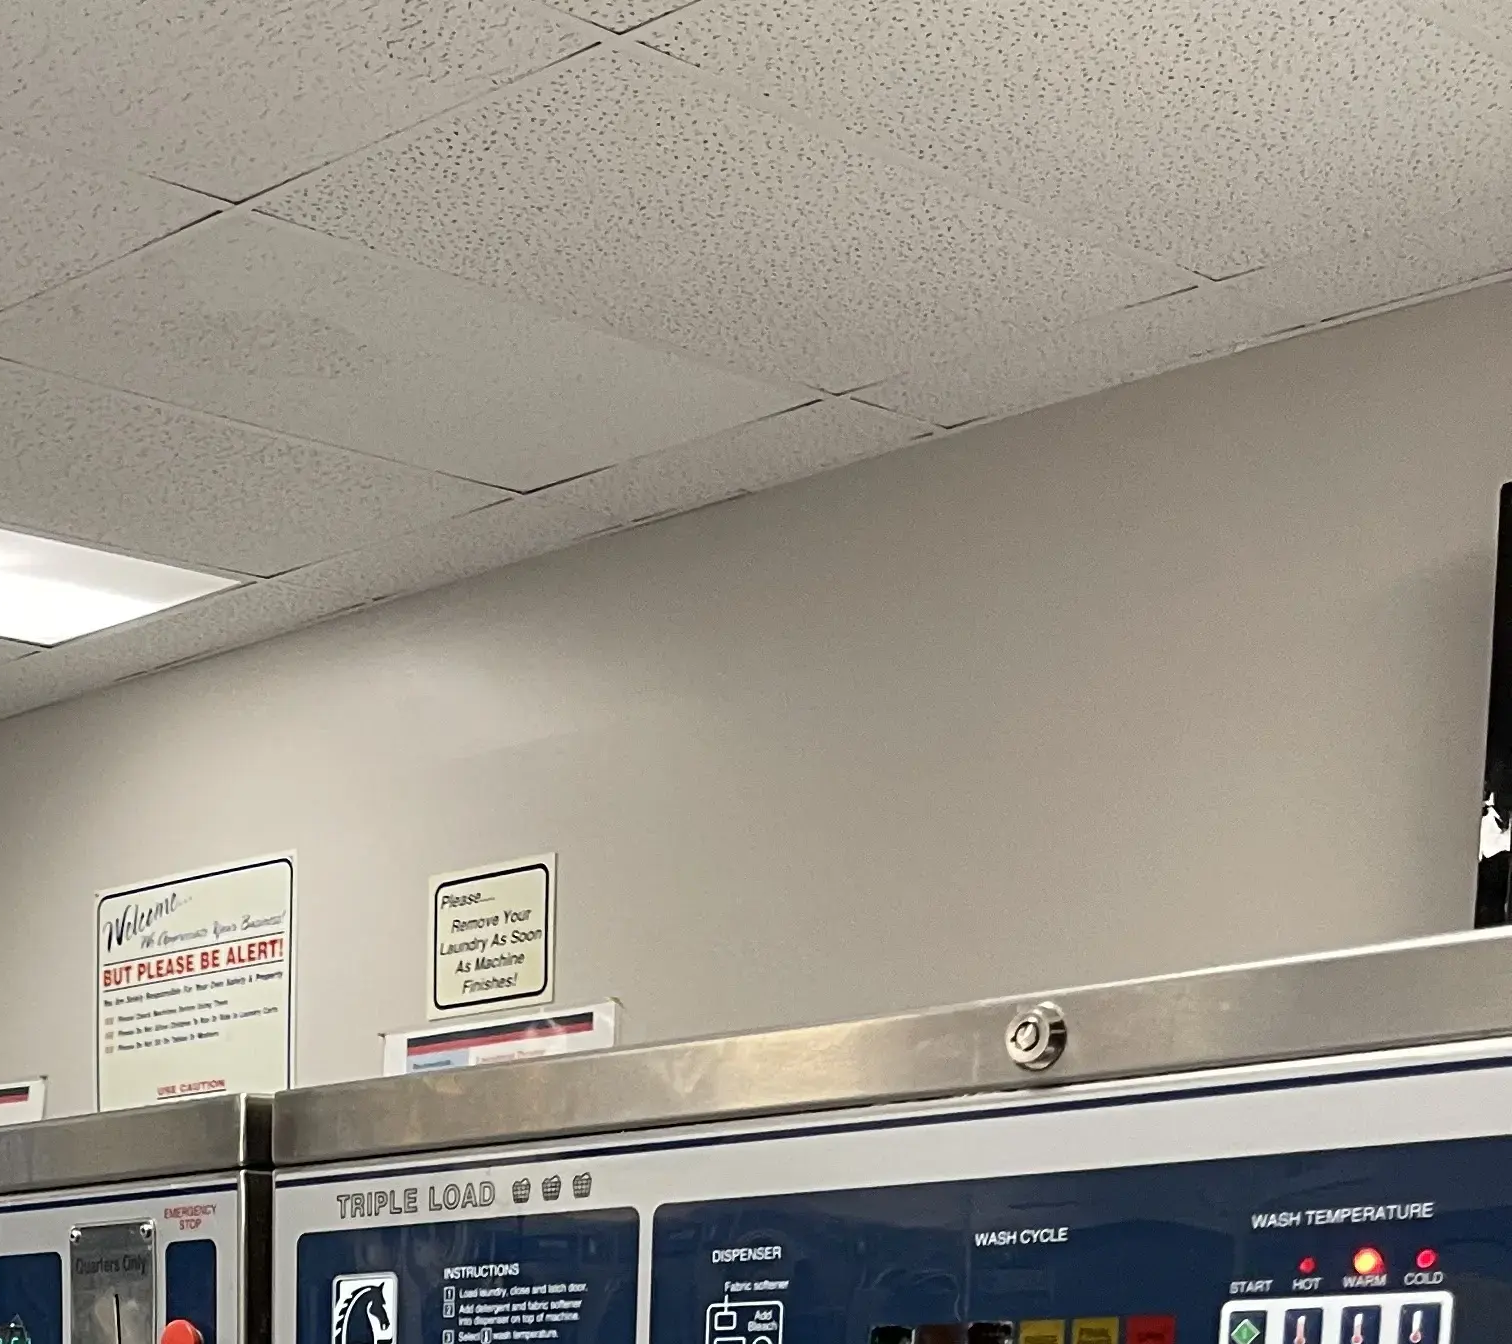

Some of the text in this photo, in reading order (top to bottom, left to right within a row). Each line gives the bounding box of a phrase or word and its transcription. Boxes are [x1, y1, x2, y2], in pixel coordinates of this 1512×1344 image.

[451, 909, 532, 933] Remove Your
[440, 929, 542, 956] Laundry As Soon
[103, 938, 284, 987] BUT PLEASE BE ALERT!
[455, 952, 525, 974] As Machine
[461, 972, 518, 994] Finishes!
[180, 1079, 225, 1094] CAUTION
[337, 1181, 495, 1219] TRIPLE LOAD
[164, 1204, 217, 1219] EMERGENCY
[1251, 1202, 1435, 1230] WASH TEMPERATURE
[179, 1219, 202, 1230] STOP
[974, 1227, 1068, 1248] WASH CYCLE
[712, 1246, 782, 1264] DISPENSER
[75, 1254, 147, 1276] Quarters Only
[443, 1263, 520, 1279] INSTRUCTIONS
[1229, 1279, 1274, 1294] START
[1292, 1277, 1323, 1291] HOT
[1342, 1273, 1388, 1288] WARM
[1403, 1272, 1443, 1285] COLD
[754, 1309, 773, 1320] Add
